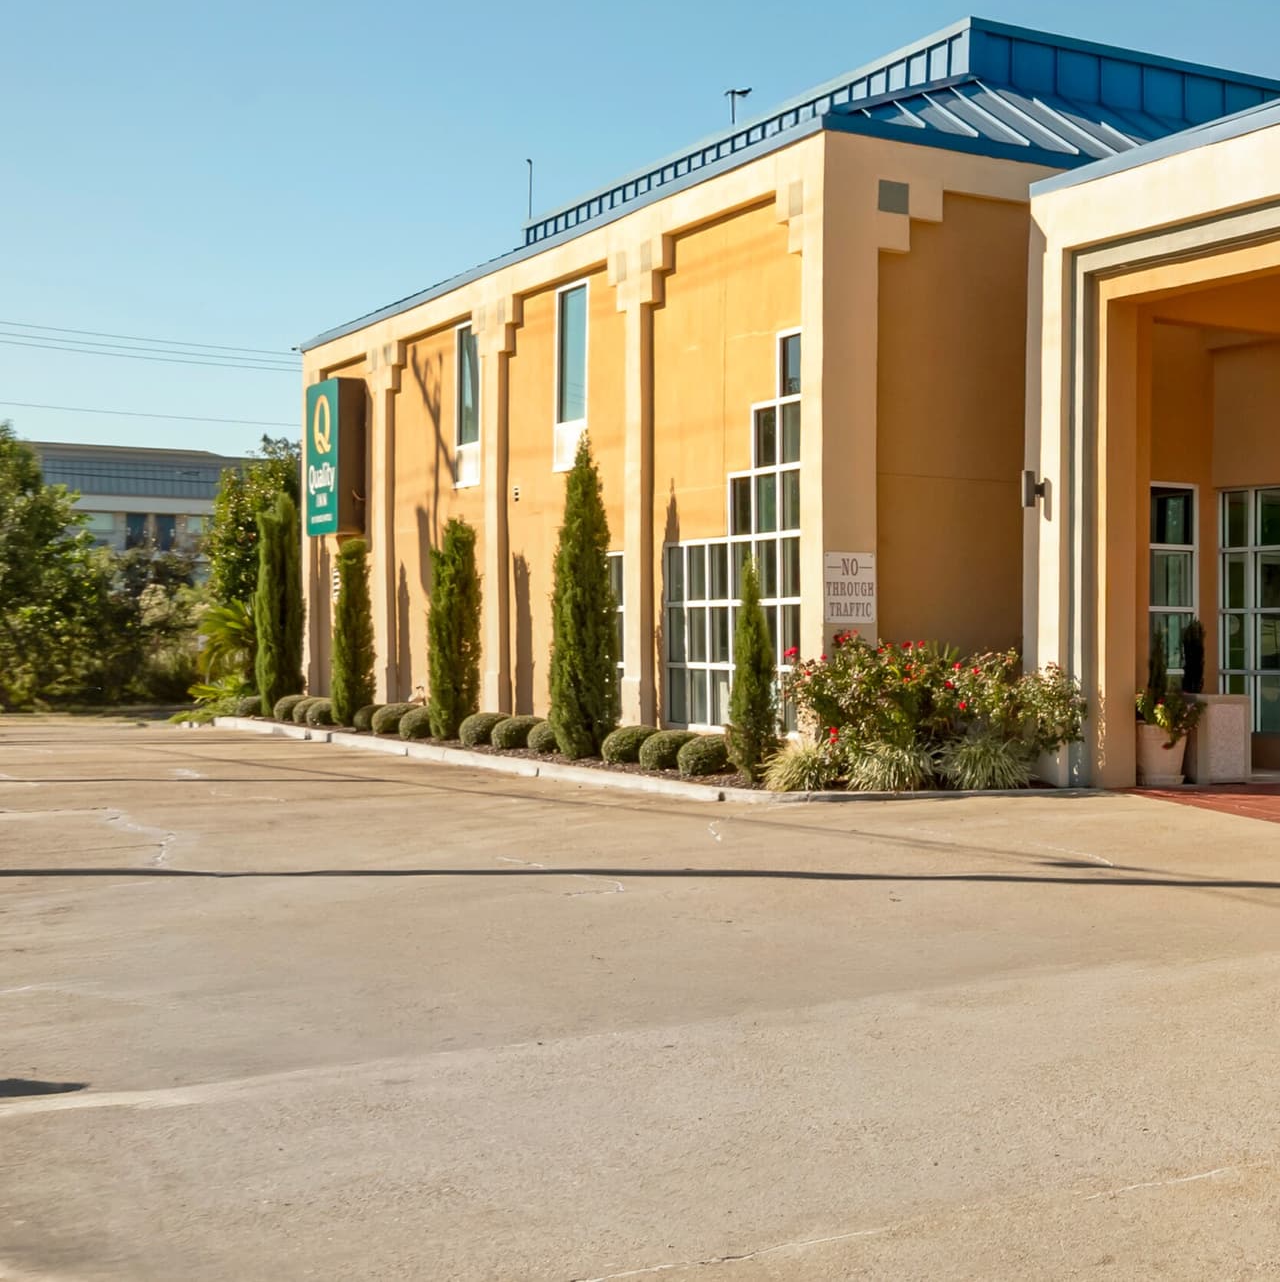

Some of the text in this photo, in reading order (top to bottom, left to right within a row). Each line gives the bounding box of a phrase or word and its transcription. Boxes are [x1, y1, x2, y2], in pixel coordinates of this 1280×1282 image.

[313, 394, 331, 454] Q
[309, 462, 336, 495] Quality
[841, 558, 859, 576] NO
[826, 581, 874, 597] THROUGH
[829, 602, 872, 617] TRAFFIC
